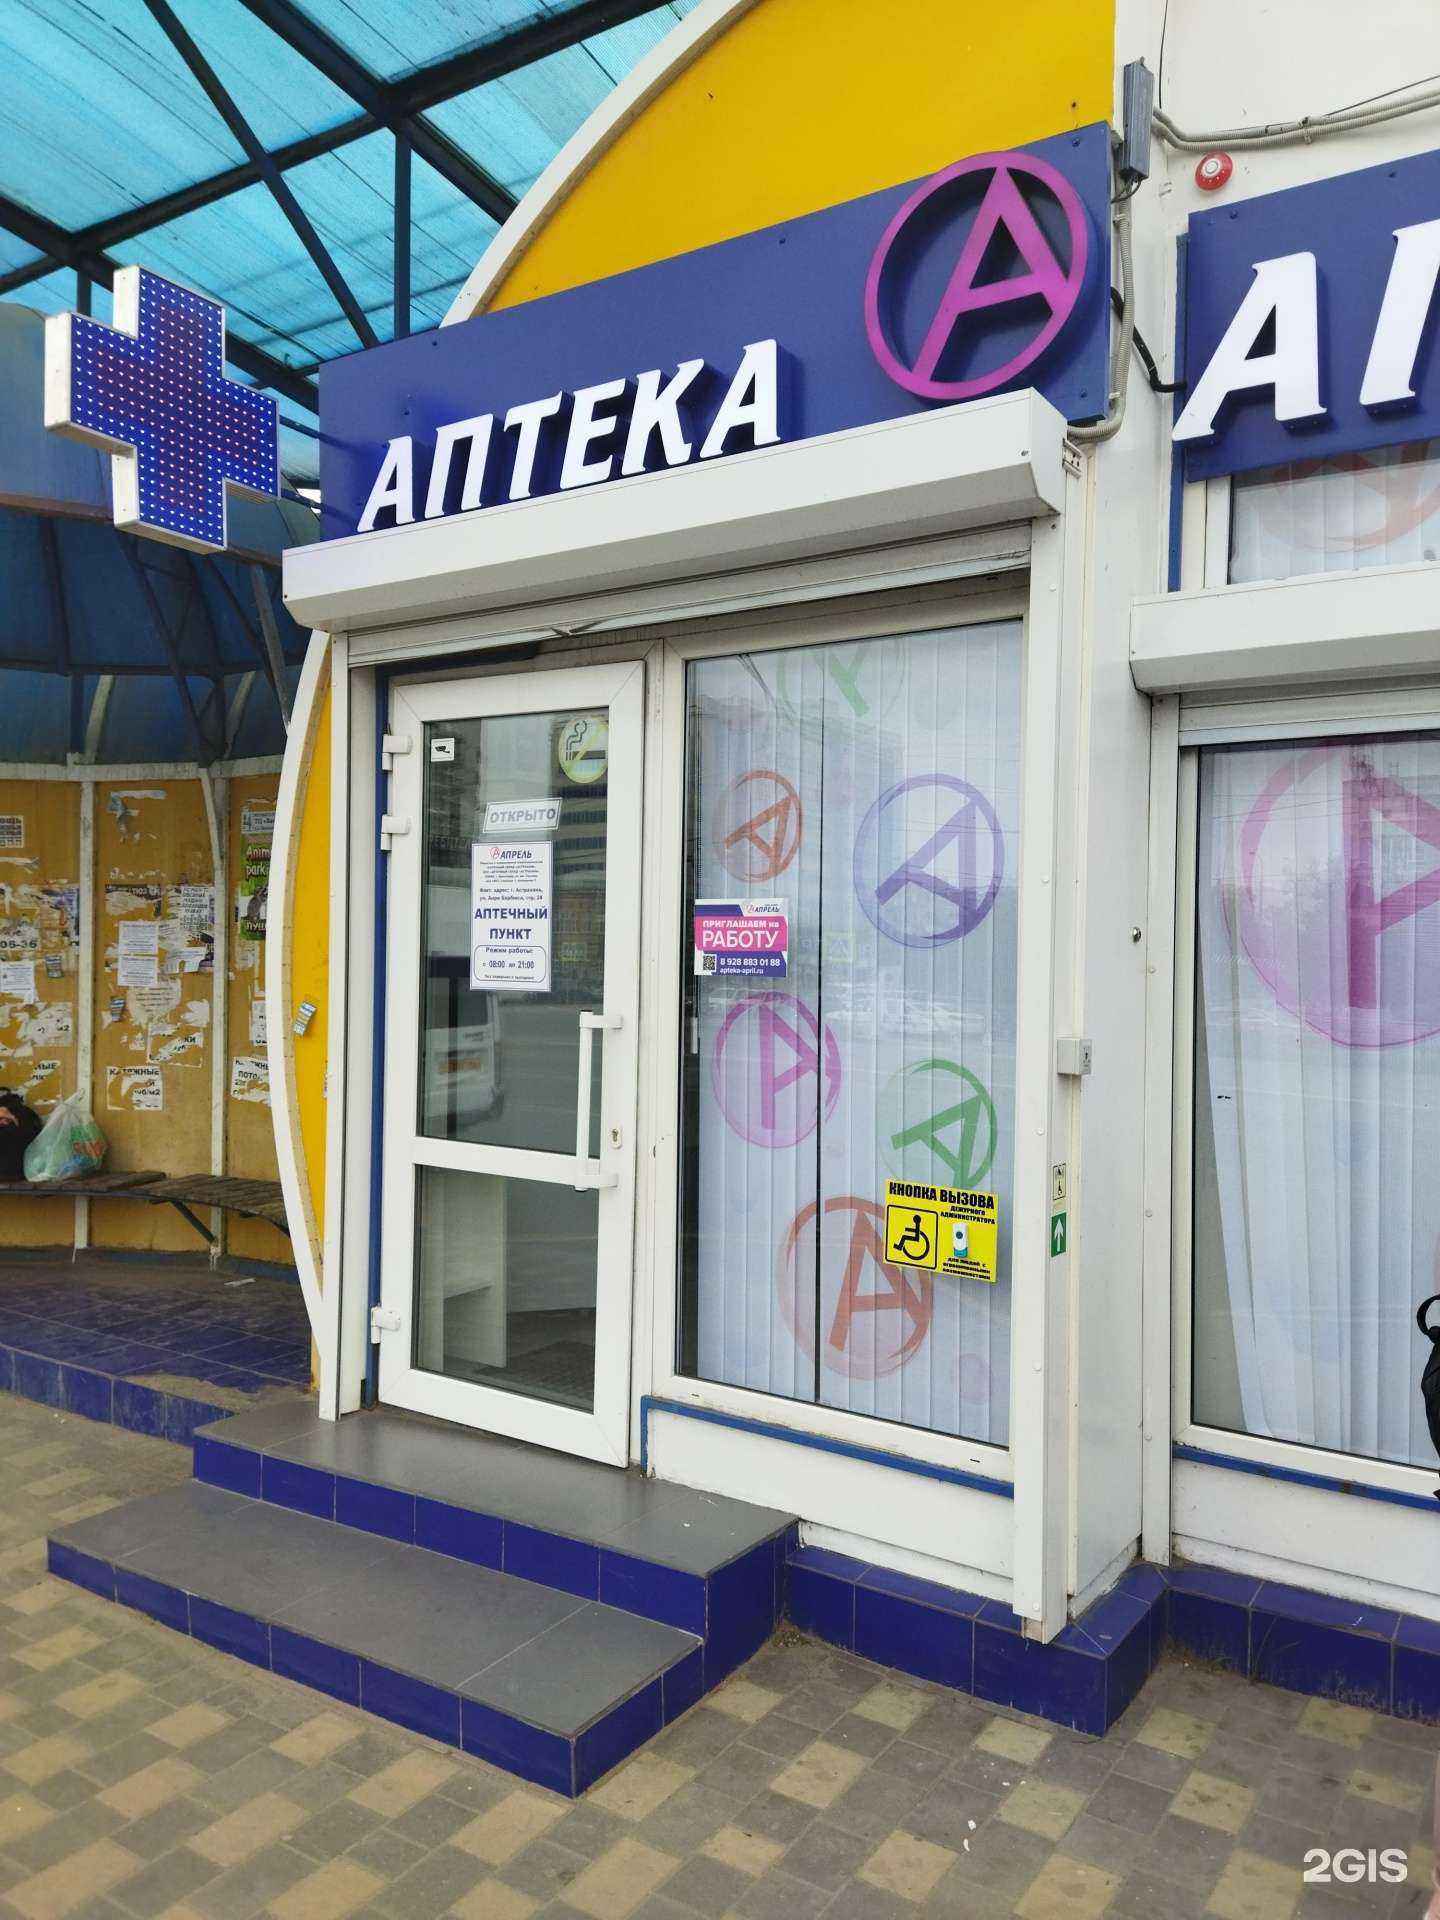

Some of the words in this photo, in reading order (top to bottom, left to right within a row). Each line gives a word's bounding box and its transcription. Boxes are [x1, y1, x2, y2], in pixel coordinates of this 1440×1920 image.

[357, 338, 781, 533] АПТЕКА
[489, 807, 557, 823] ОТКРЫТО
[500, 850, 532, 860] АПРЕЛЬ
[474, 906, 548, 920] АПТЕЧНЫЙ
[703, 920, 767, 928] ПРИГЛАШАЕМ
[489, 928, 532, 940] ПУНКТ
[702, 930, 780, 948] РАБОТУ
[517, 960, 535, 969] 21:00
[889, 1181, 938, 1201] КНОПКА
[940, 1189, 995, 1210] ВЫЗОВА
